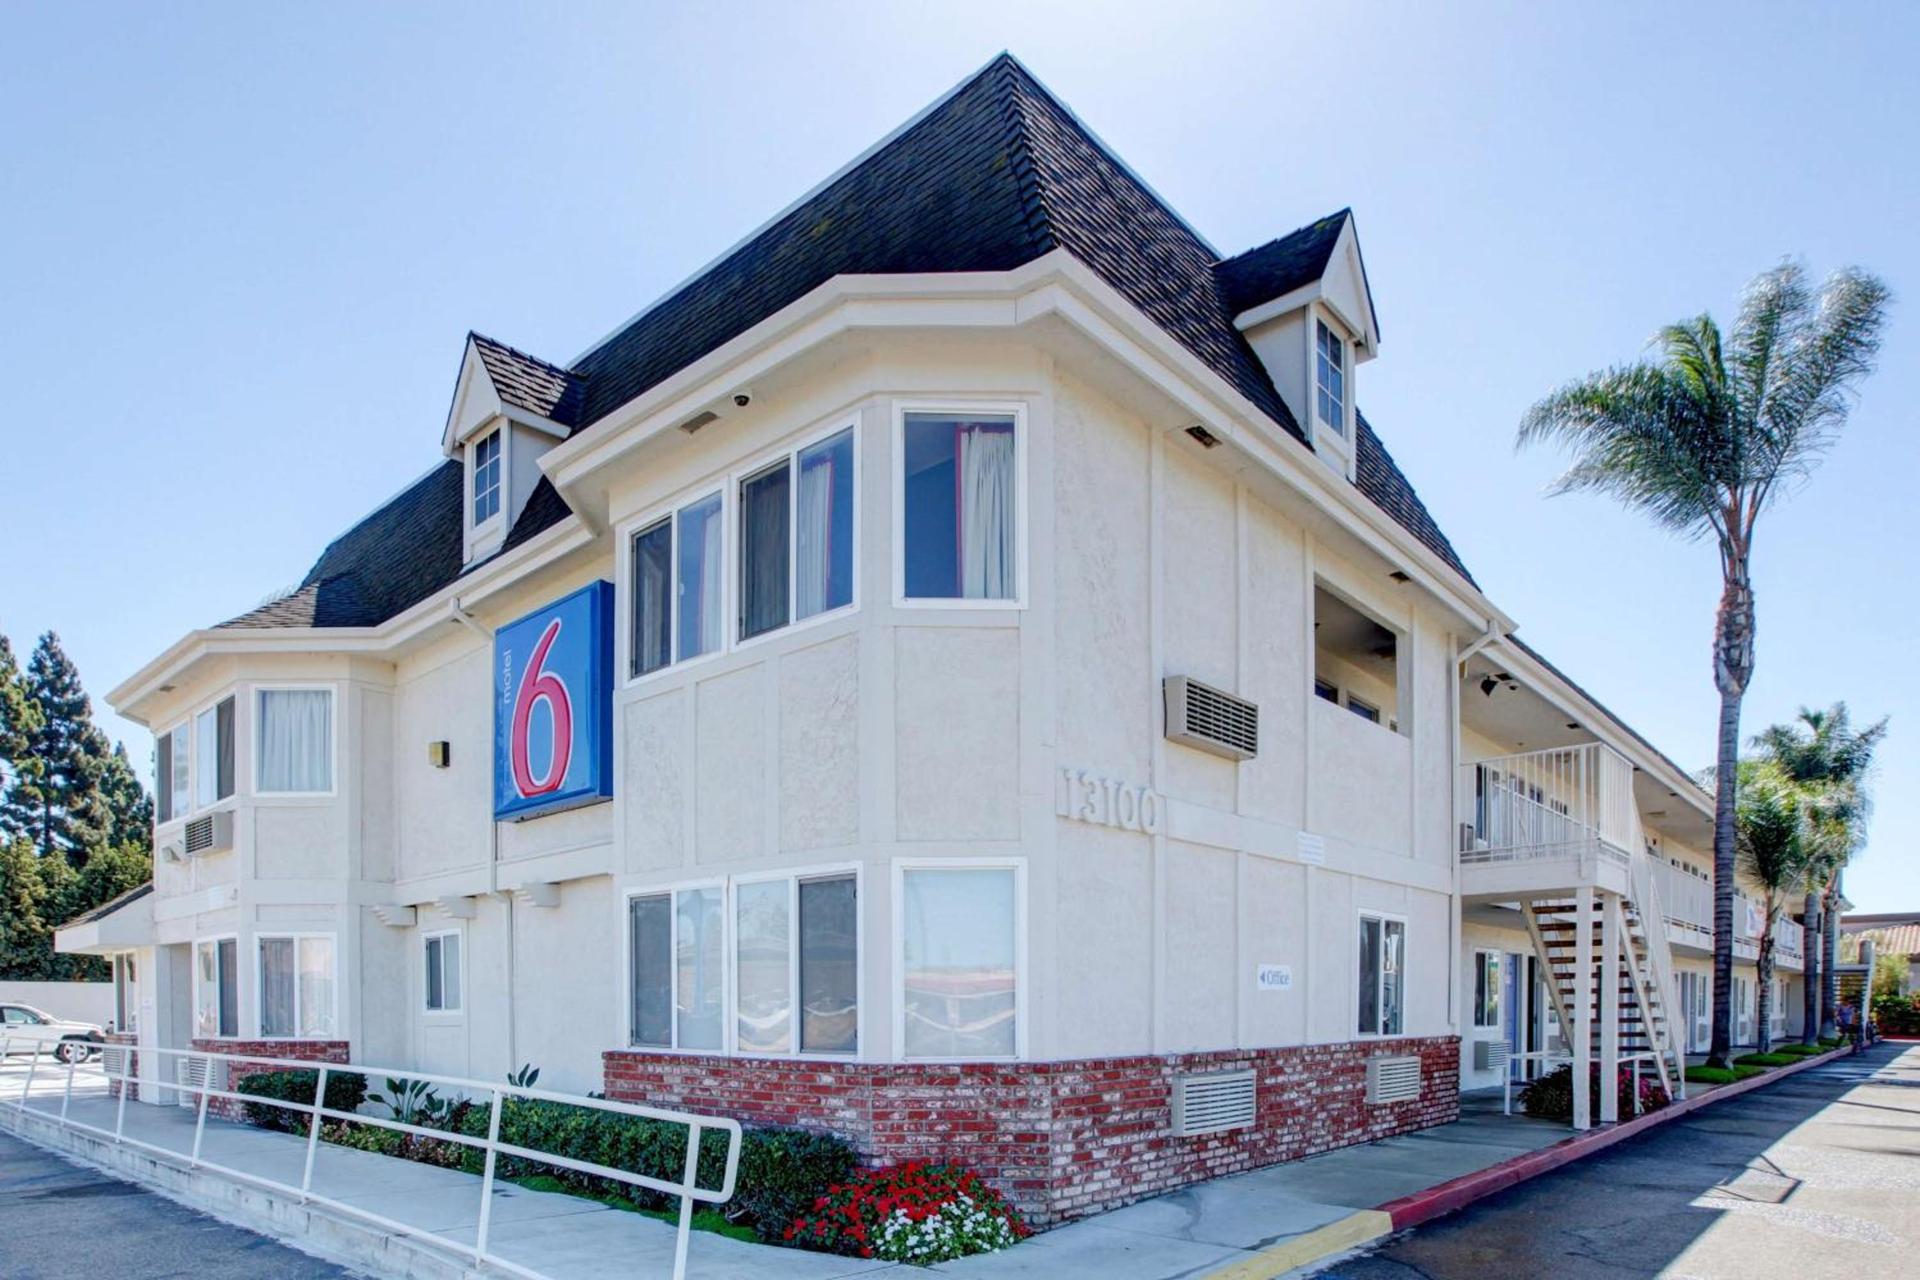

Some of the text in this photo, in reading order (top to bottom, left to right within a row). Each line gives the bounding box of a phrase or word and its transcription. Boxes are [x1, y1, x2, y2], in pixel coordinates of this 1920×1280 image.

[503, 649, 512, 704] motel
[511, 617, 574, 798] 6
[1061, 767, 1161, 834] 13100
[1266, 969, 1290, 985] Office
